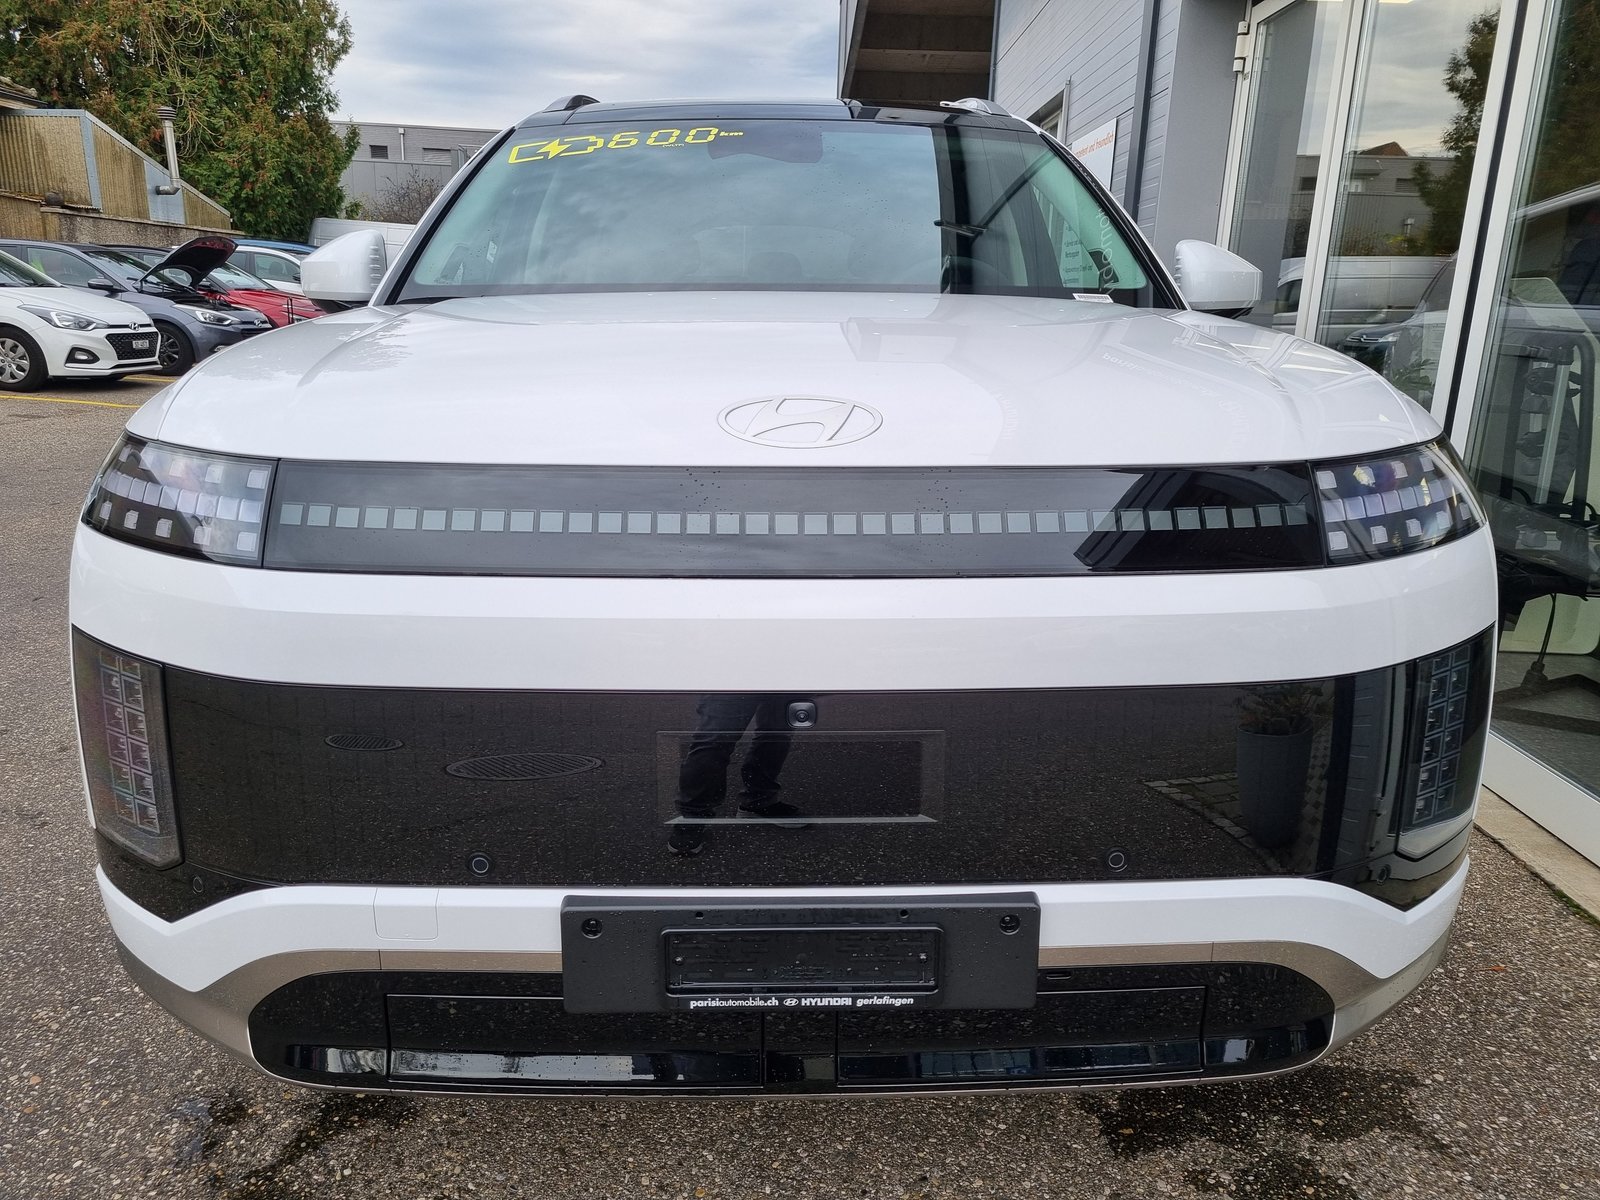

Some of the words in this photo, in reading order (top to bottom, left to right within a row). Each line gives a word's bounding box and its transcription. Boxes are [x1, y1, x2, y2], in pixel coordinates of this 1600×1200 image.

[607, 127, 719, 148] 600
[690, 997, 779, 1009] parisiautomobile.ch
[801, 997, 852, 1006] HYUNDAI
[856, 996, 914, 1007] gerlafingen
